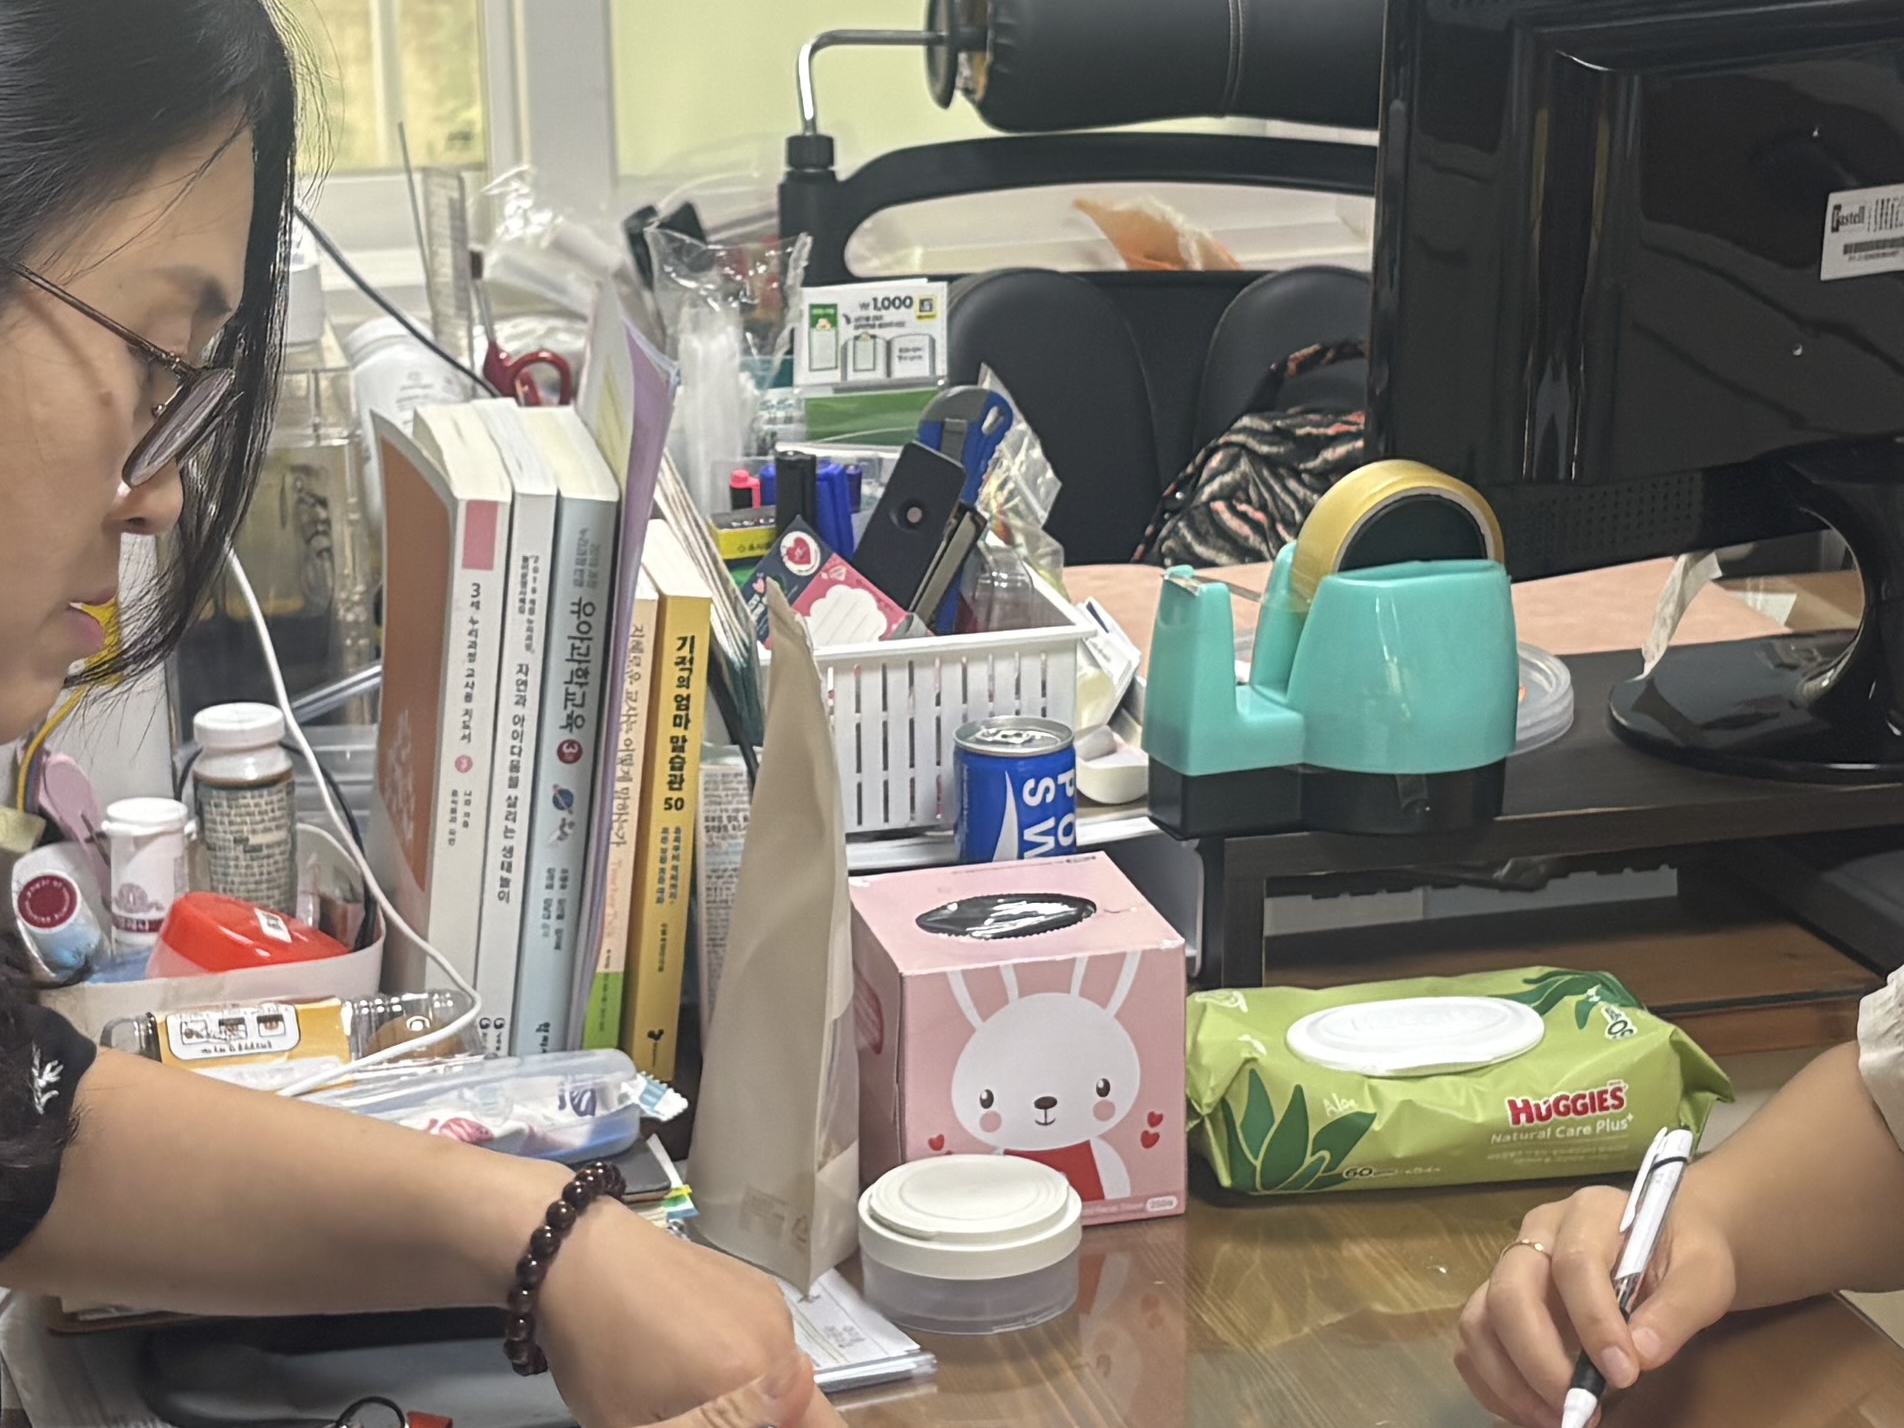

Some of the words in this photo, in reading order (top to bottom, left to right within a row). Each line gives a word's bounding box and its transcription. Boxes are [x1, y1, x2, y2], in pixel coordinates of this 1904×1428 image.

[469, 582, 482, 611] 3세
[559, 598, 596, 734] 유아과학교육
[625, 622, 645, 685] 지혜로운
[673, 634, 695, 689] 기적의
[513, 662, 530, 708] 자연과
[622, 688, 640, 735] 교사는
[672, 693, 692, 731] 엄마
[506, 715, 524, 789] 아이다움을
[617, 737, 636, 783] 어떻게
[502, 795, 519, 840] 살리는
[612, 786, 632, 848] 말하는가
[664, 796, 685, 812] 50
[496, 845, 515, 904] 생태놀이
[1322, 1093, 1358, 1117] Aloe
[1507, 1083, 1624, 1127] HUGGIES
[1490, 1125, 1551, 1147] Natural
[1553, 1121, 1592, 1139] Care
